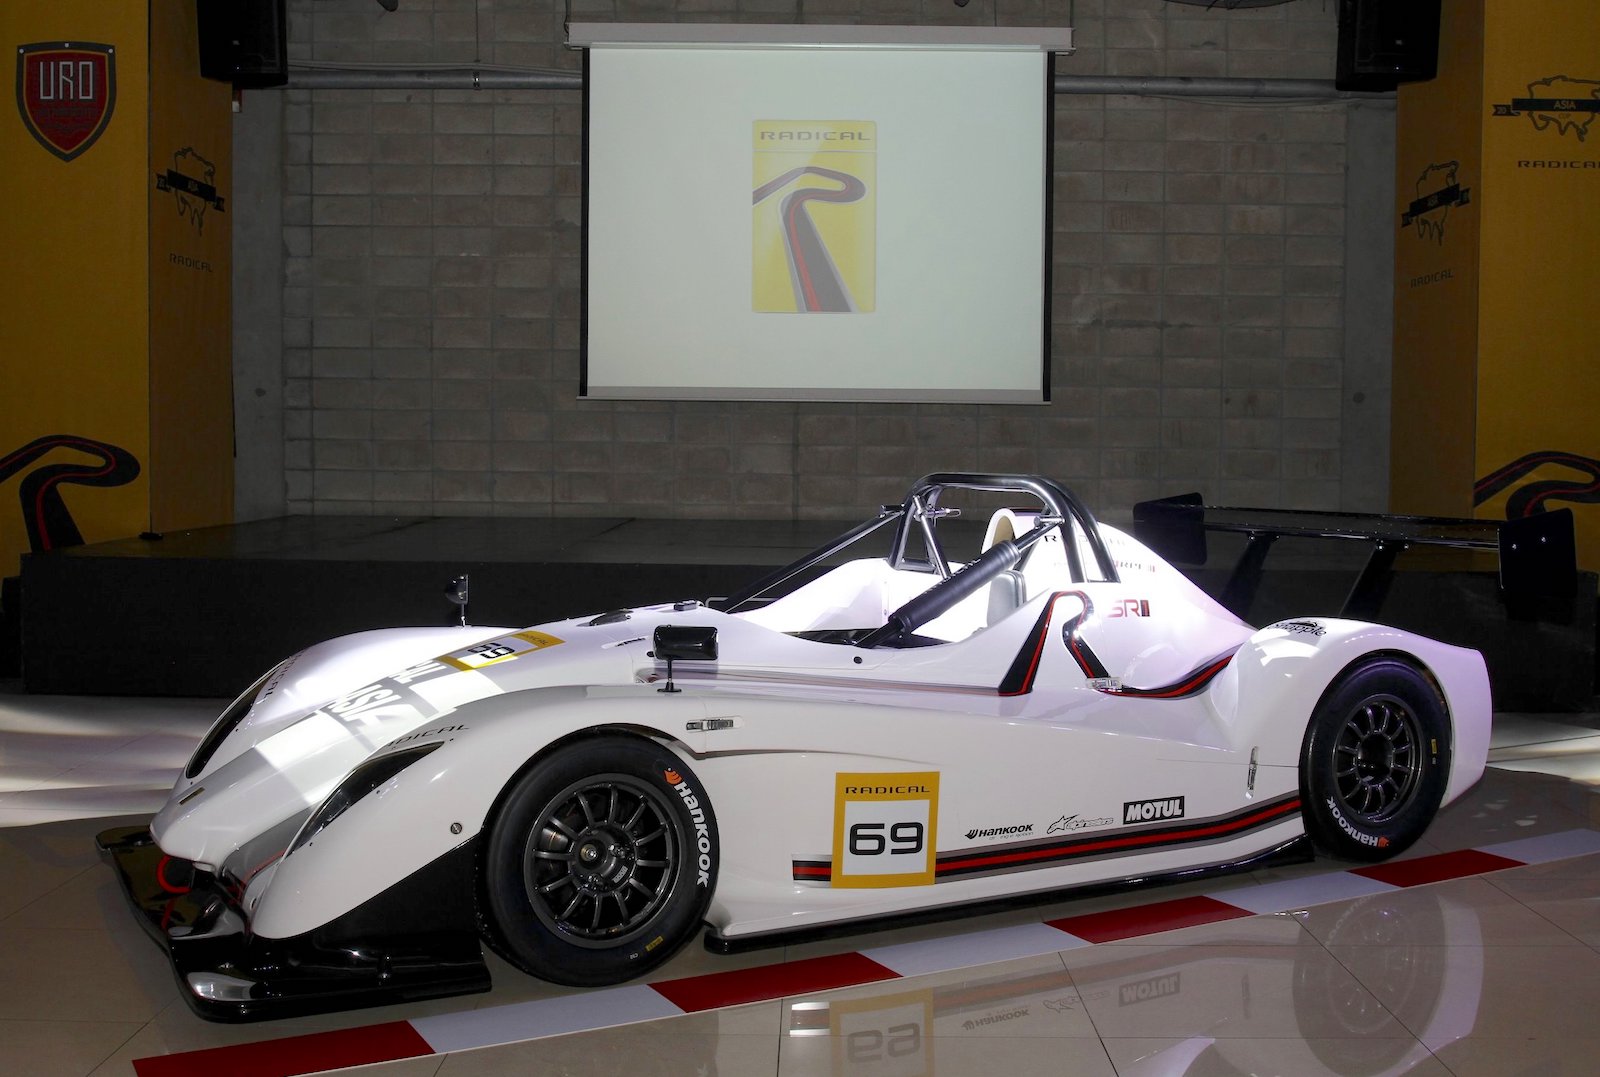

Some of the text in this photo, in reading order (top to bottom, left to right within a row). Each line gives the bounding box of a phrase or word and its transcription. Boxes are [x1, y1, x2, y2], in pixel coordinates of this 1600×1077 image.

[39, 61, 94, 100] URO
[1553, 100, 1576, 110] ASIA
[760, 131, 871, 141] RADICAL
[1517, 160, 1600, 169] RADICA
[169, 252, 214, 273] RADICAL
[1410, 270, 1454, 289] RADICAL
[386, 724, 470, 746] DICAL
[844, 785, 931, 795] RADICAL
[1125, 798, 1183, 821] MOTUL
[849, 821, 924, 856] 69
